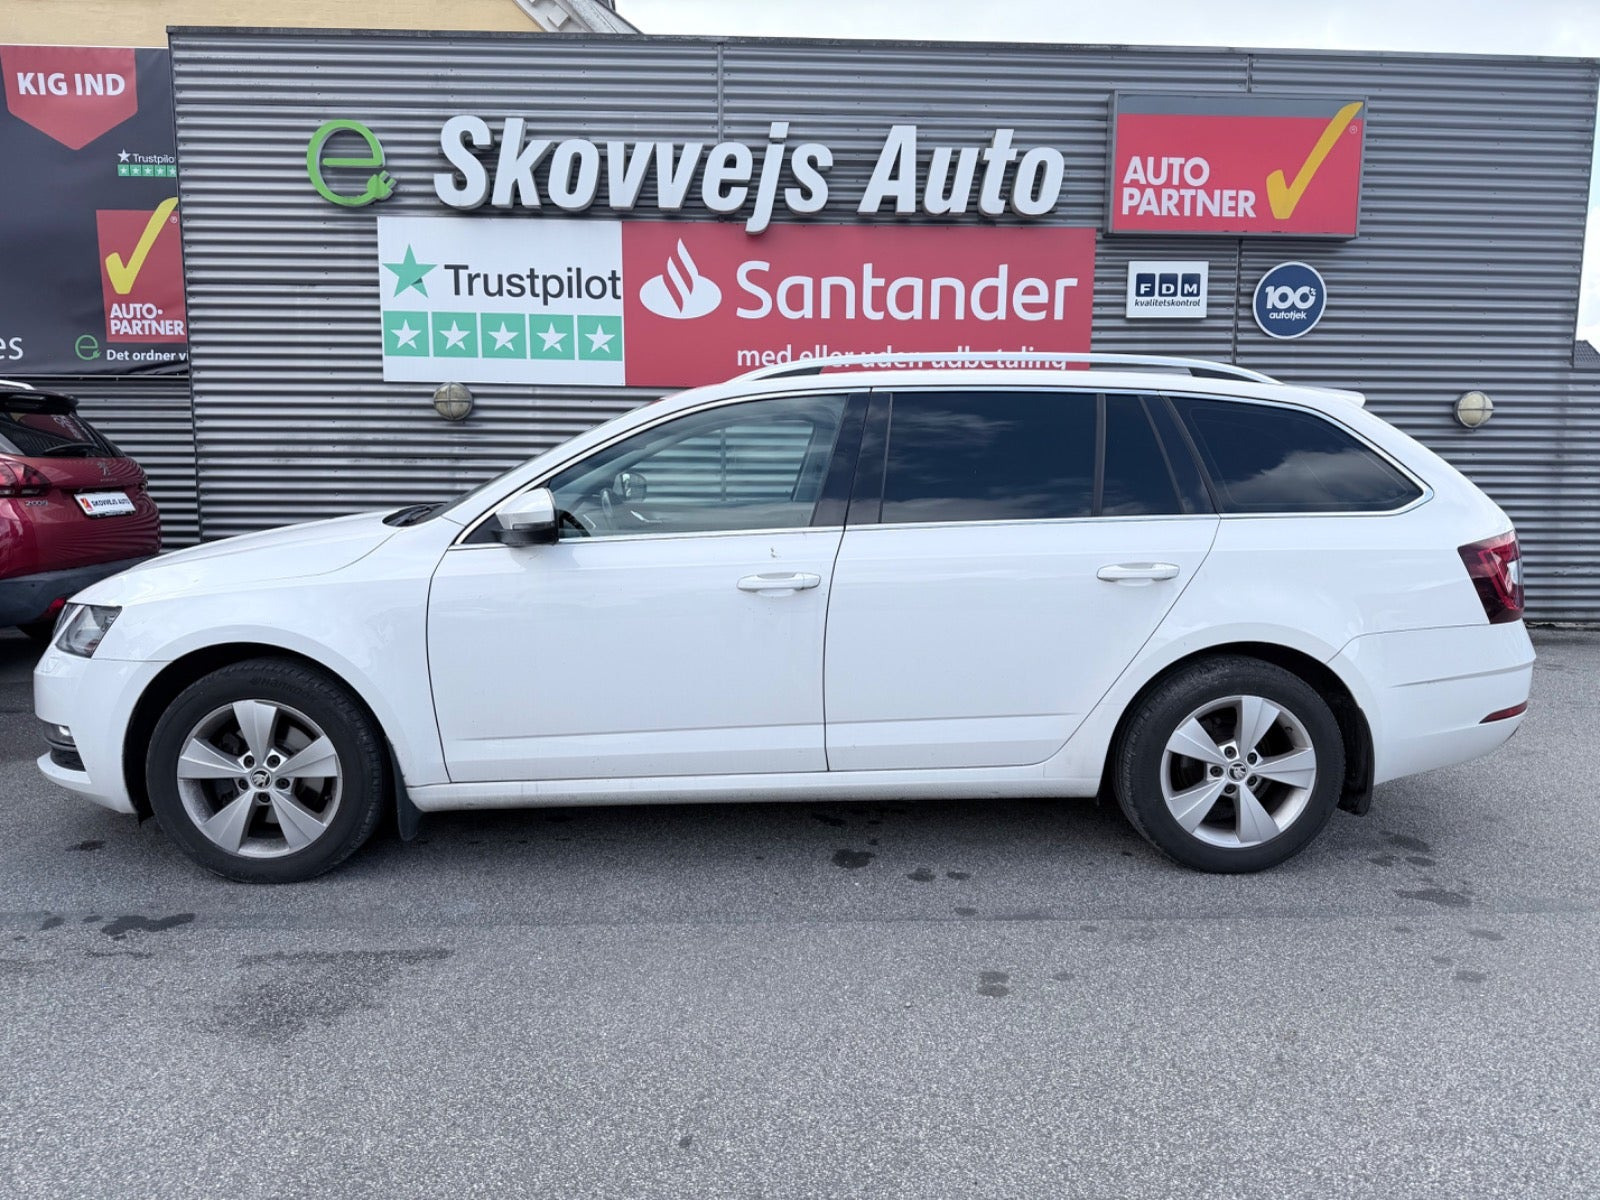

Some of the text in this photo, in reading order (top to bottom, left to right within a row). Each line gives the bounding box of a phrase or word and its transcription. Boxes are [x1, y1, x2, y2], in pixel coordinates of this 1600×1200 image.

[17, 72, 126, 96] KIG IND
[132, 153, 176, 165] Trustpilo
[433, 115, 1066, 235] Skovvejs Auto
[1123, 156, 1210, 187] AUTO
[1121, 187, 1257, 218] PARTNER
[444, 264, 622, 306] Trustpilot
[735, 260, 1079, 321] Santander
[1138, 280, 1200, 297] FDM
[1134, 298, 1202, 307] kvalitetskontrol
[1268, 309, 1307, 321] autotjek
[110, 319, 185, 335] PARTNER
[106, 349, 129, 361] Det
[132, 349, 176, 361] ordner
[736, 344, 792, 367] med
